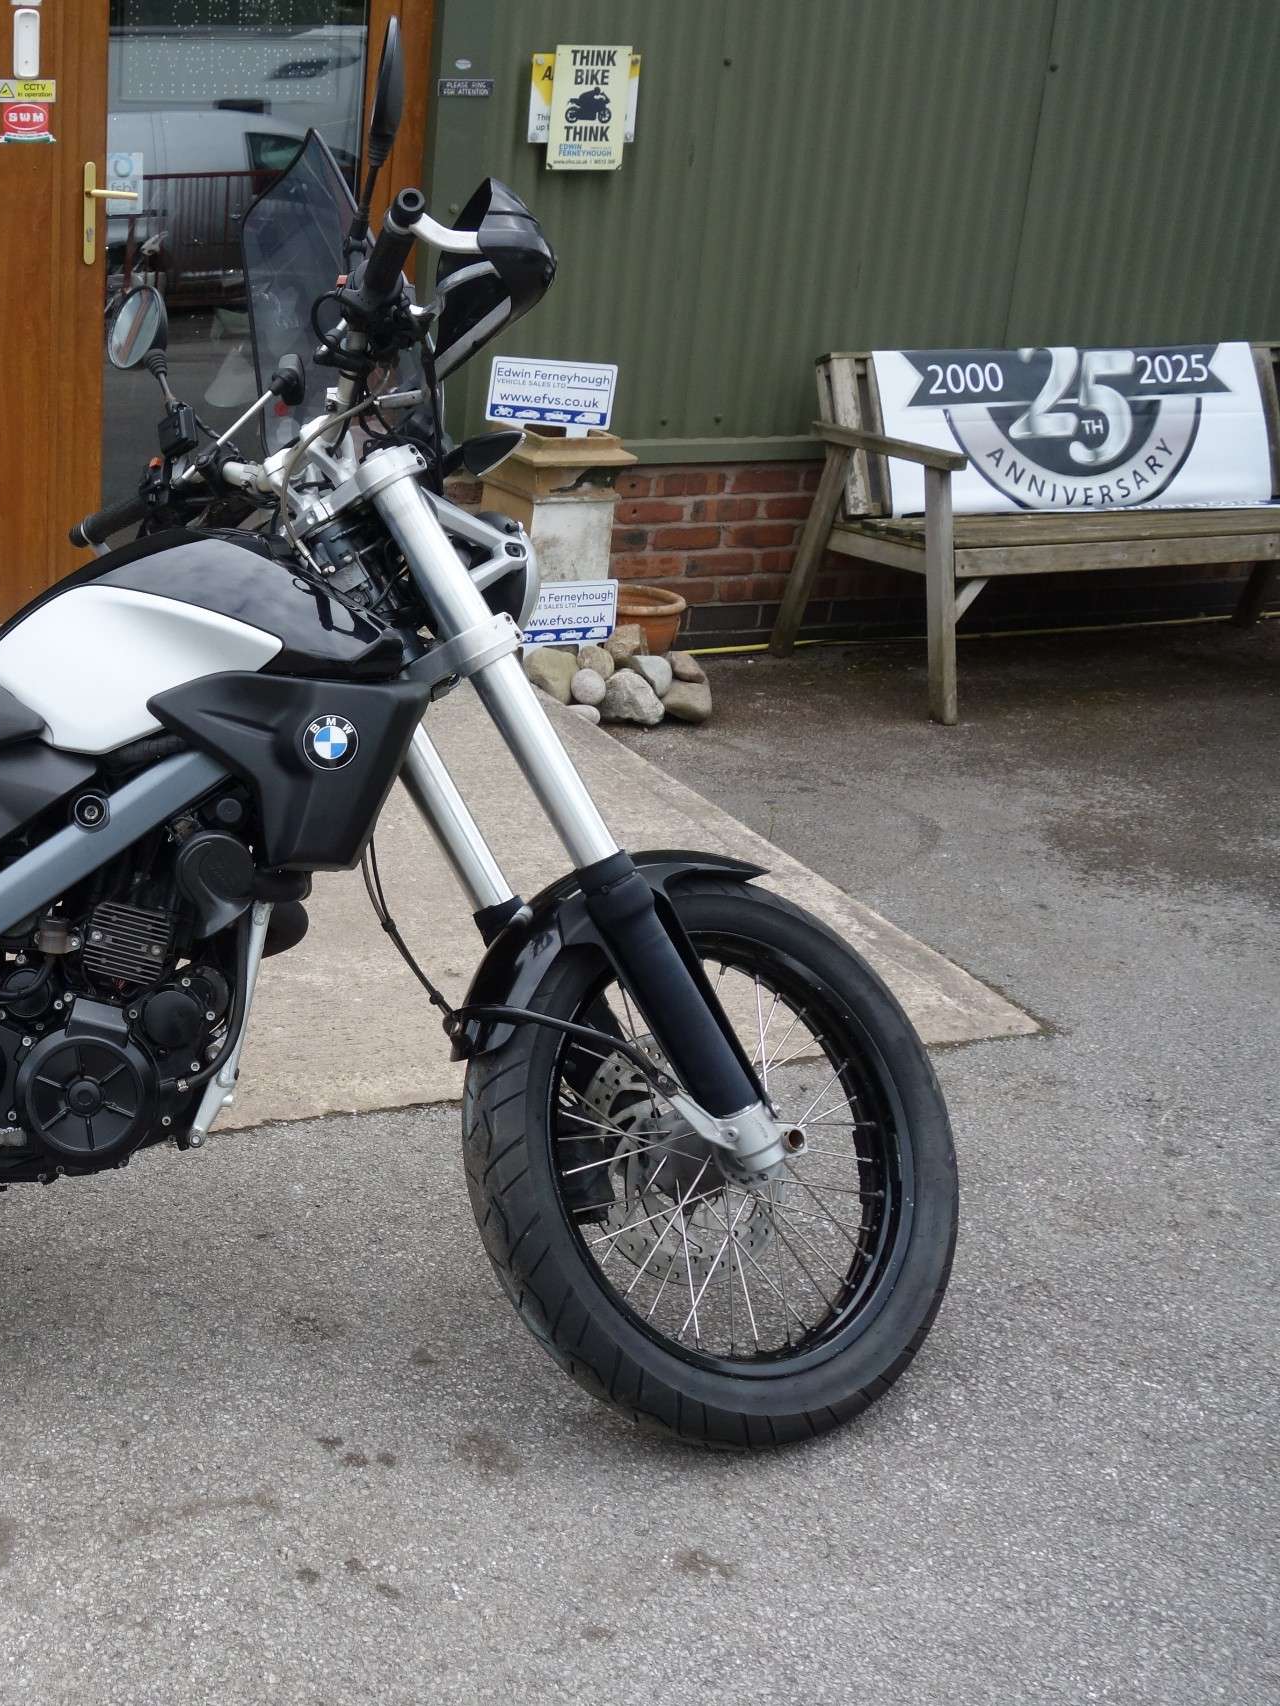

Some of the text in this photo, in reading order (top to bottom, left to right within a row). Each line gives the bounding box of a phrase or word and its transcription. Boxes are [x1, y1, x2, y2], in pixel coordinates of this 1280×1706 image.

[571, 50, 617, 66] THINK
[574, 69, 609, 85] BIKE
[23, 83, 46, 91] CCTV
[564, 126, 609, 142] THINK
[558, 149, 612, 157] FERNEYHOUGH
[496, 367, 610, 387] Edwin Ferneyhough
[496, 378, 526, 386] VEHICLE
[500, 391, 600, 408] www.efvs.co.uk
[926, 346, 1209, 466] 2000 25 2025
[1081, 419, 1104, 435] TH
[986, 437, 1174, 507] ANNIVERSARY
[548, 590, 613, 604] Ferneyhough
[529, 612, 606, 627] ww.efvs.co.uk
[310, 717, 354, 735] BMW
